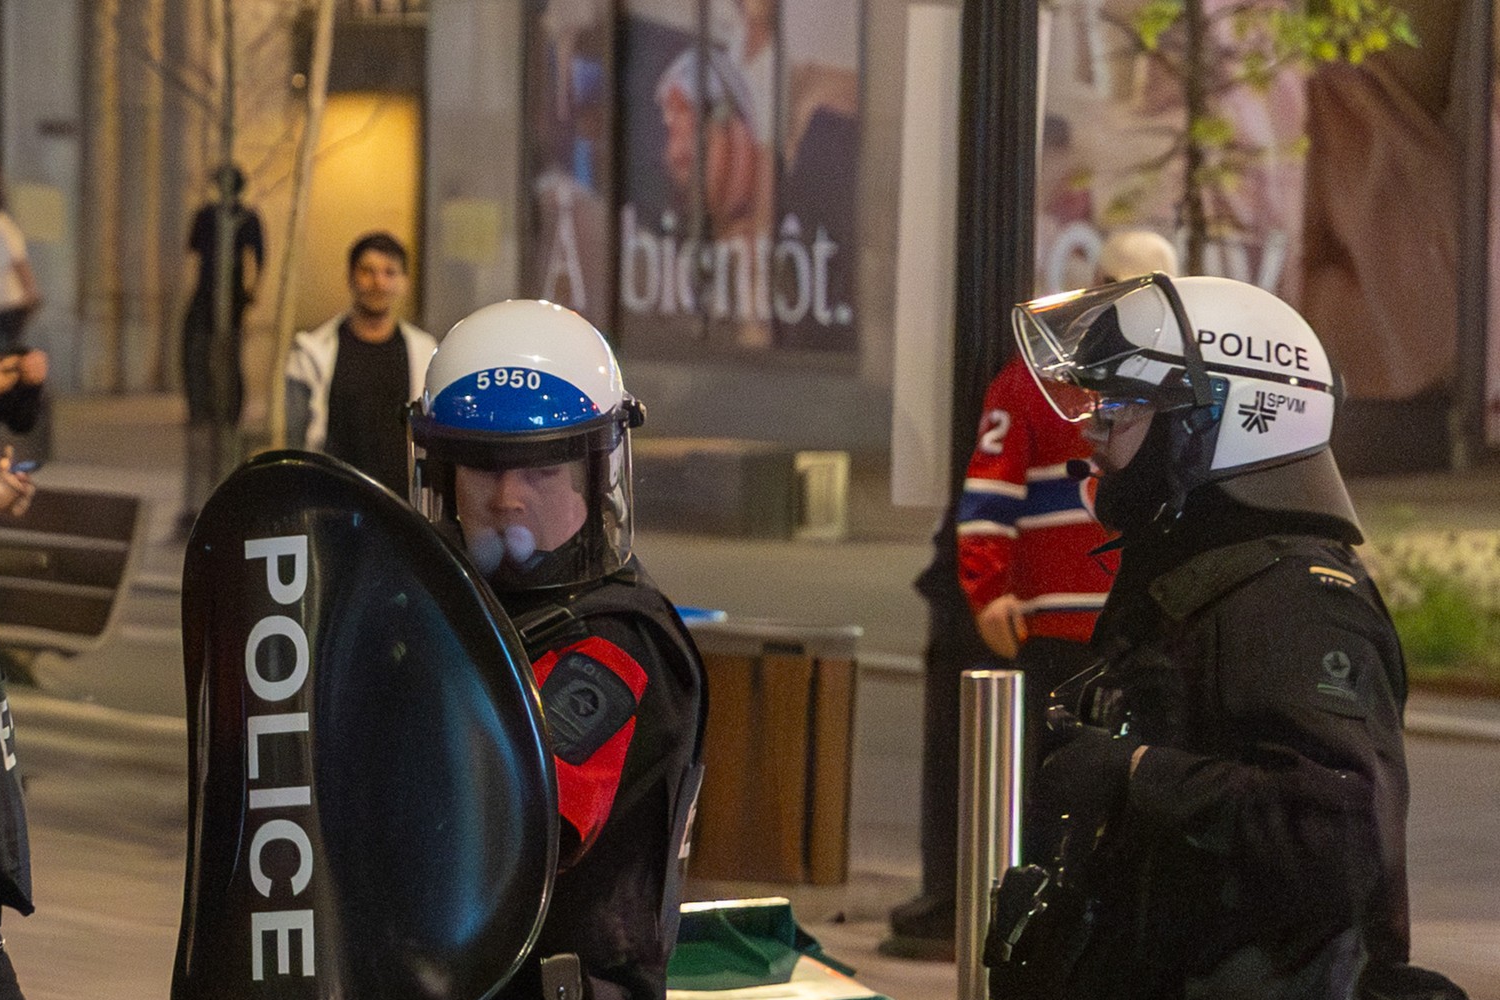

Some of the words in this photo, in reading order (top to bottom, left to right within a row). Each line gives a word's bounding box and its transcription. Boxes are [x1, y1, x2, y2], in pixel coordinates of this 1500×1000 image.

[1198, 329, 1310, 372] POLICE
[477, 368, 541, 391] 5950
[1266, 391, 1307, 414] SPVM
[243, 534, 316, 982] POLICE
